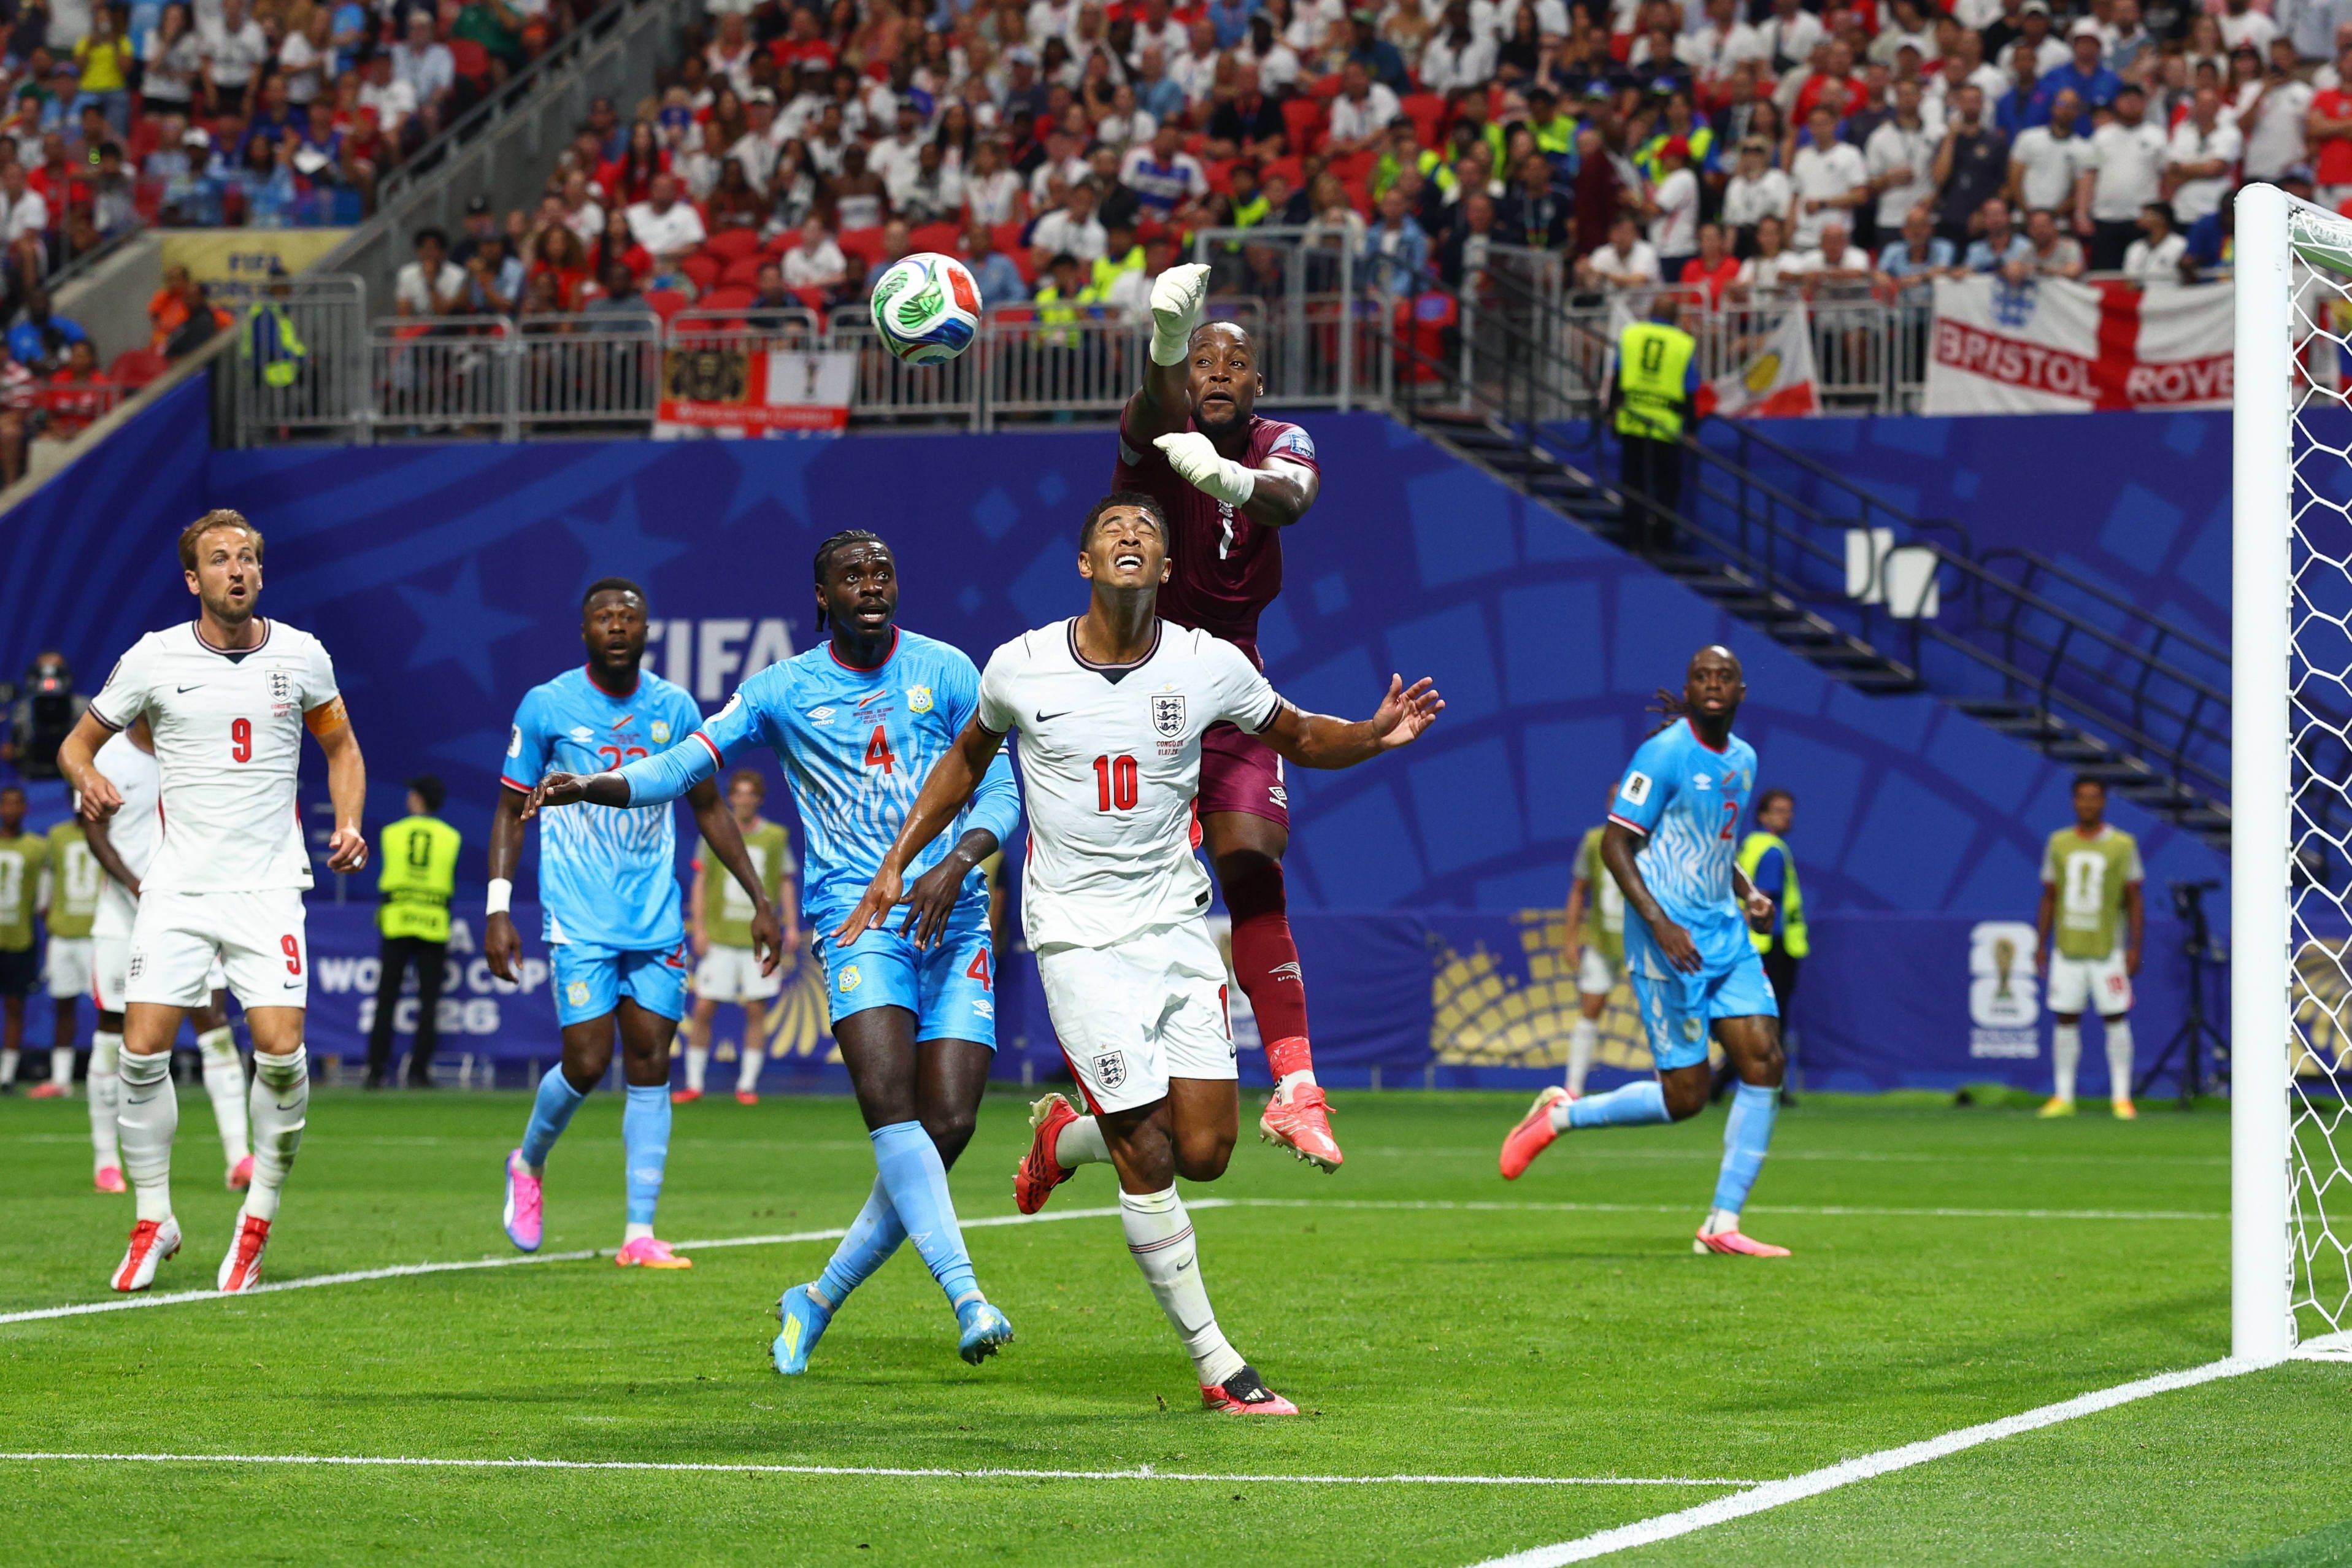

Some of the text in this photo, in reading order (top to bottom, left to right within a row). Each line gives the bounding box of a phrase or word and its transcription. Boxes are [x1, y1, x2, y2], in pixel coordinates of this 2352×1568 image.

[1937, 322, 2104, 400] BRISTOL
[232, 718, 252, 763] 9
[864, 724, 896, 775] 4
[1093, 755, 1138, 812] 10
[1720, 801, 1739, 840] 2
[280, 934, 301, 975] 9
[466, 957, 548, 994] CUP
[966, 946, 991, 993] 4
